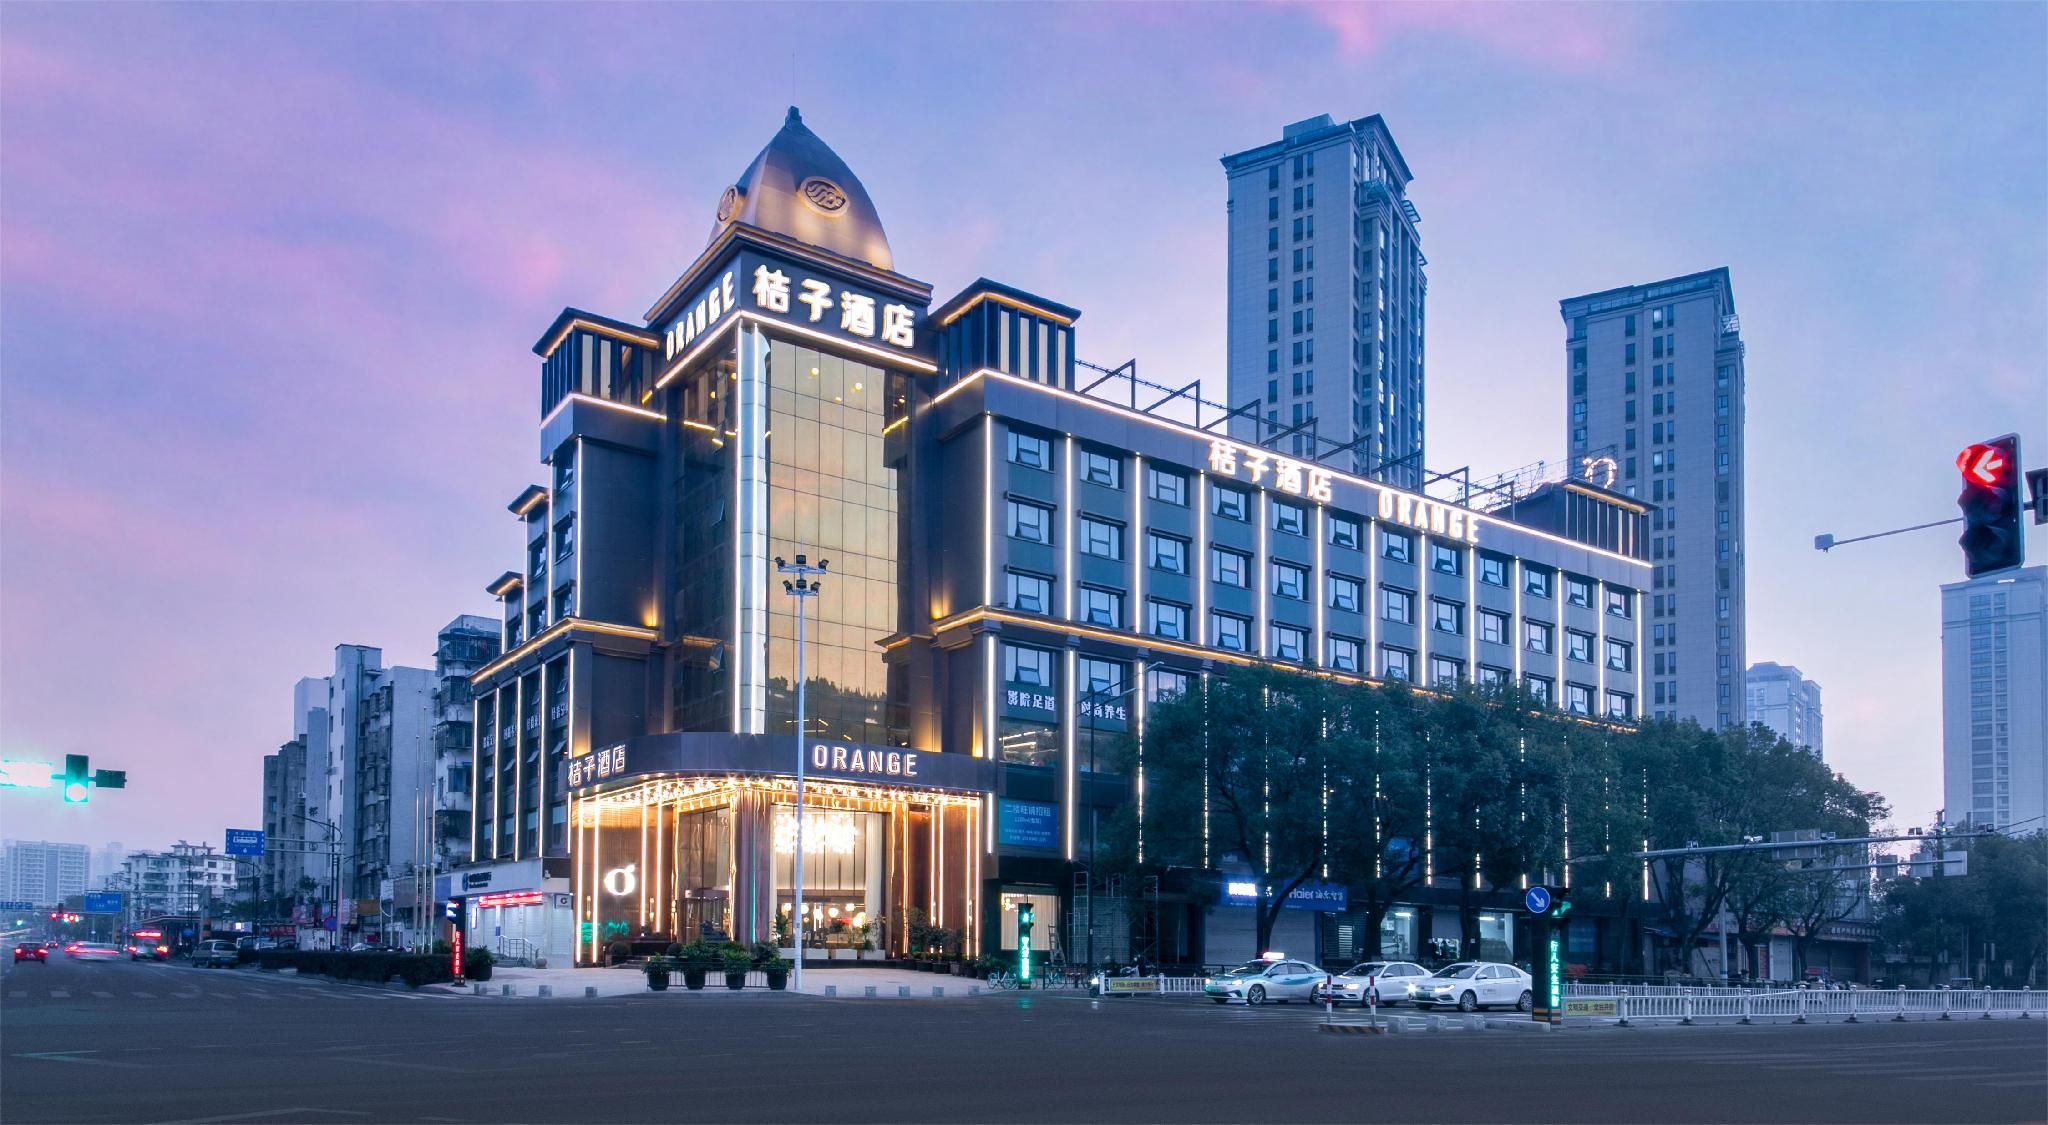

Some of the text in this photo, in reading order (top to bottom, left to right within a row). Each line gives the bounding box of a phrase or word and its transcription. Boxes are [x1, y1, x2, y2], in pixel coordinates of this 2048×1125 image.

[665, 271, 736, 362] ORANGE
[752, 264, 915, 348] 桔子酒店
[1208, 438, 1333, 503] 桔子酒店
[1377, 487, 1480, 544] ORANGE
[567, 744, 627, 787] 桔子酒店
[813, 744, 917, 776] ORANGE
